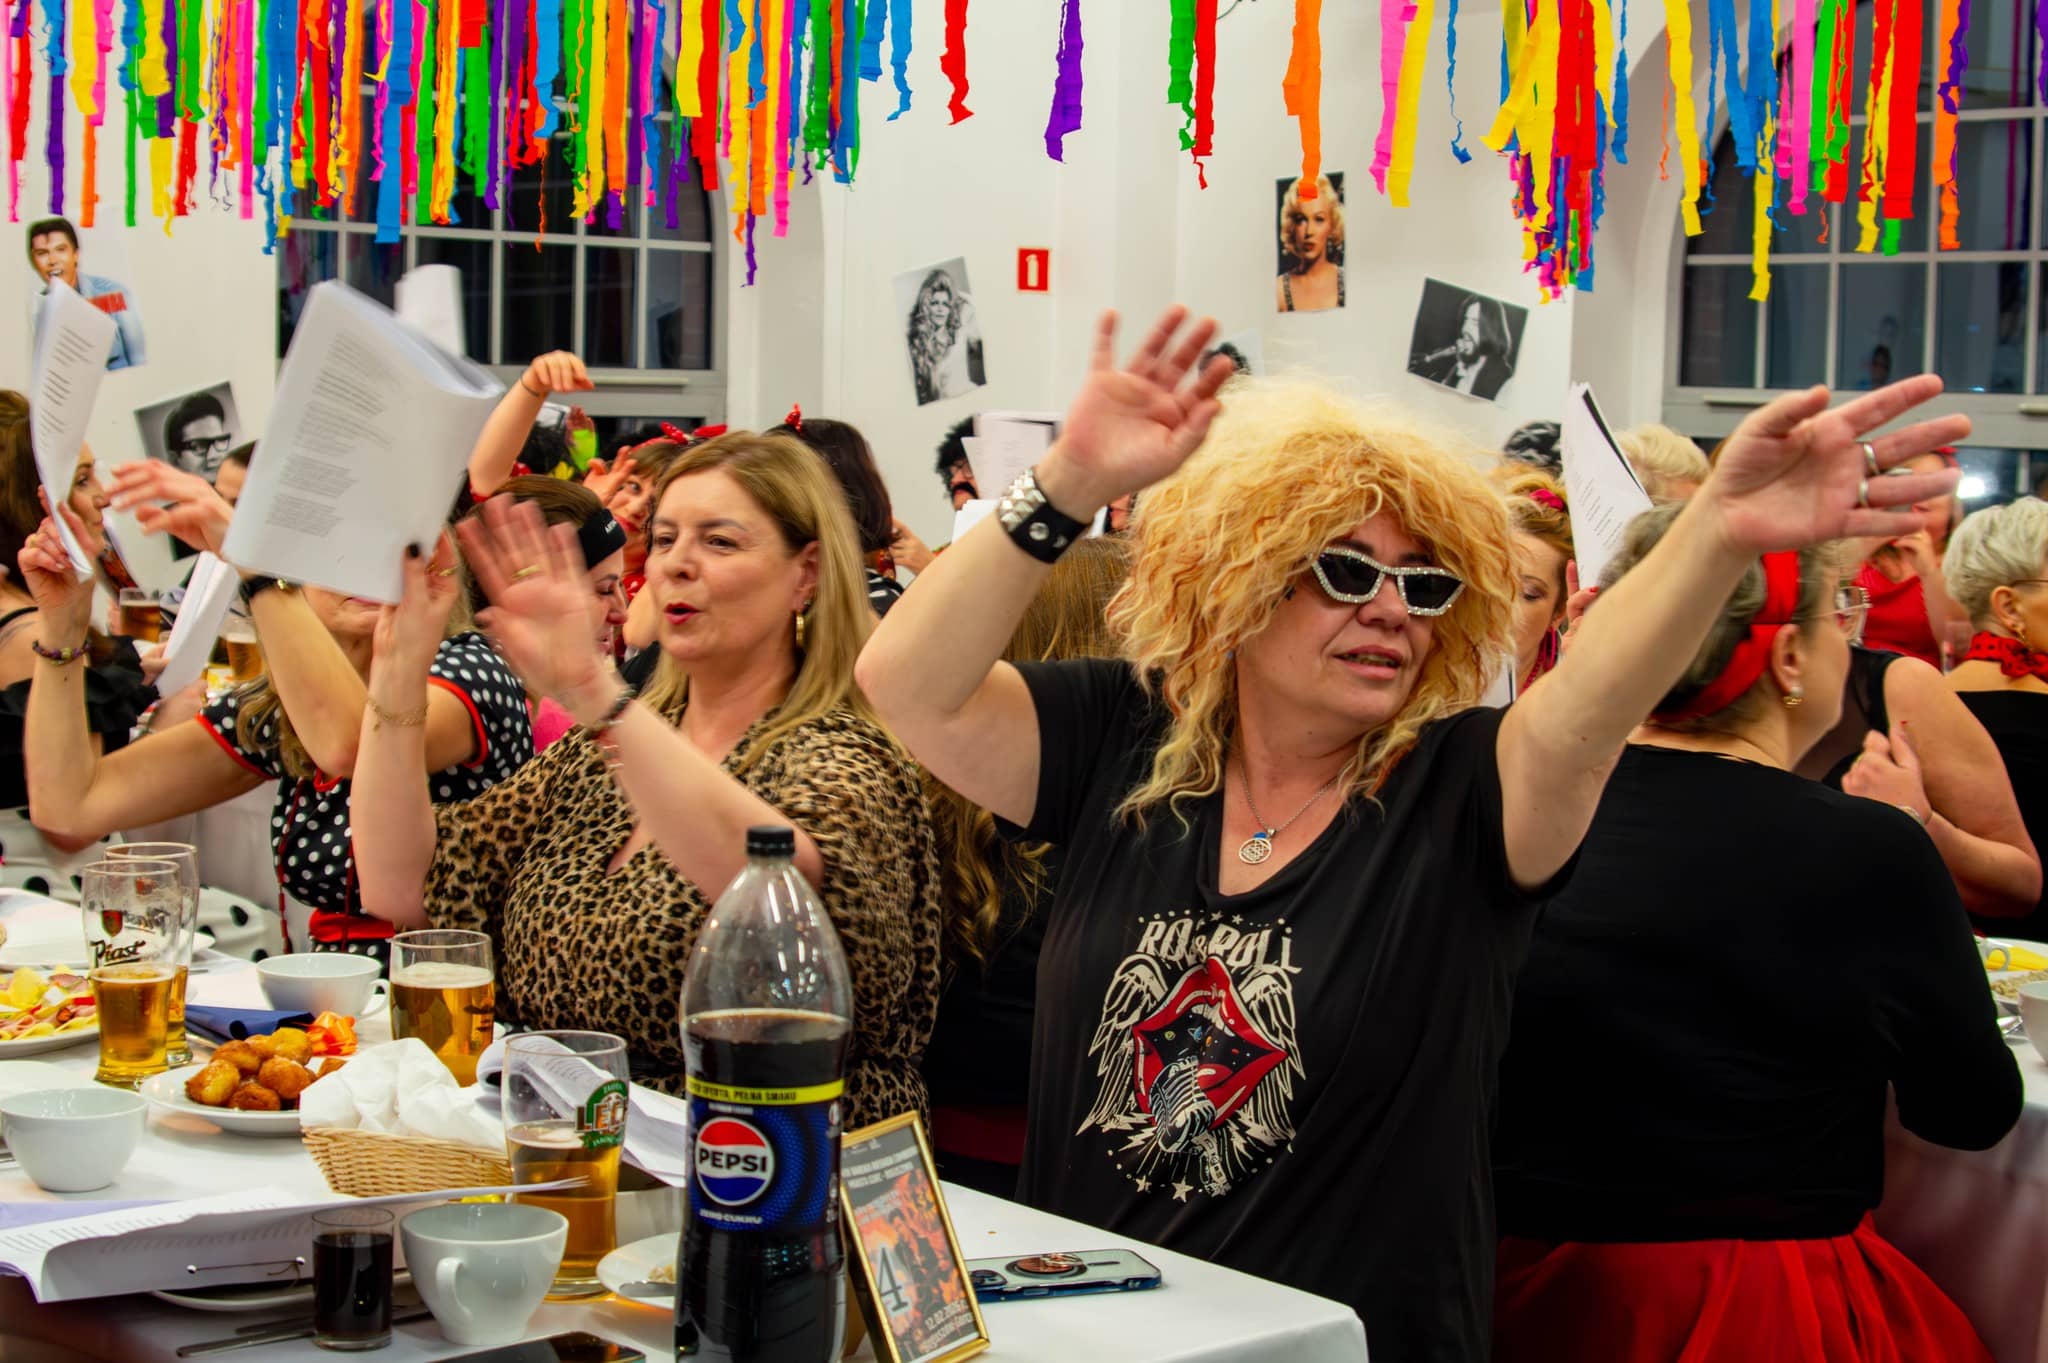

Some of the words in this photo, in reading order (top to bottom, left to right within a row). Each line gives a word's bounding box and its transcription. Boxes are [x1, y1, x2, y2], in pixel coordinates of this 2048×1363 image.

[90, 940, 146, 969] Piast
[699, 1149, 768, 1173] PEPSI
[878, 1247, 909, 1312] 4
